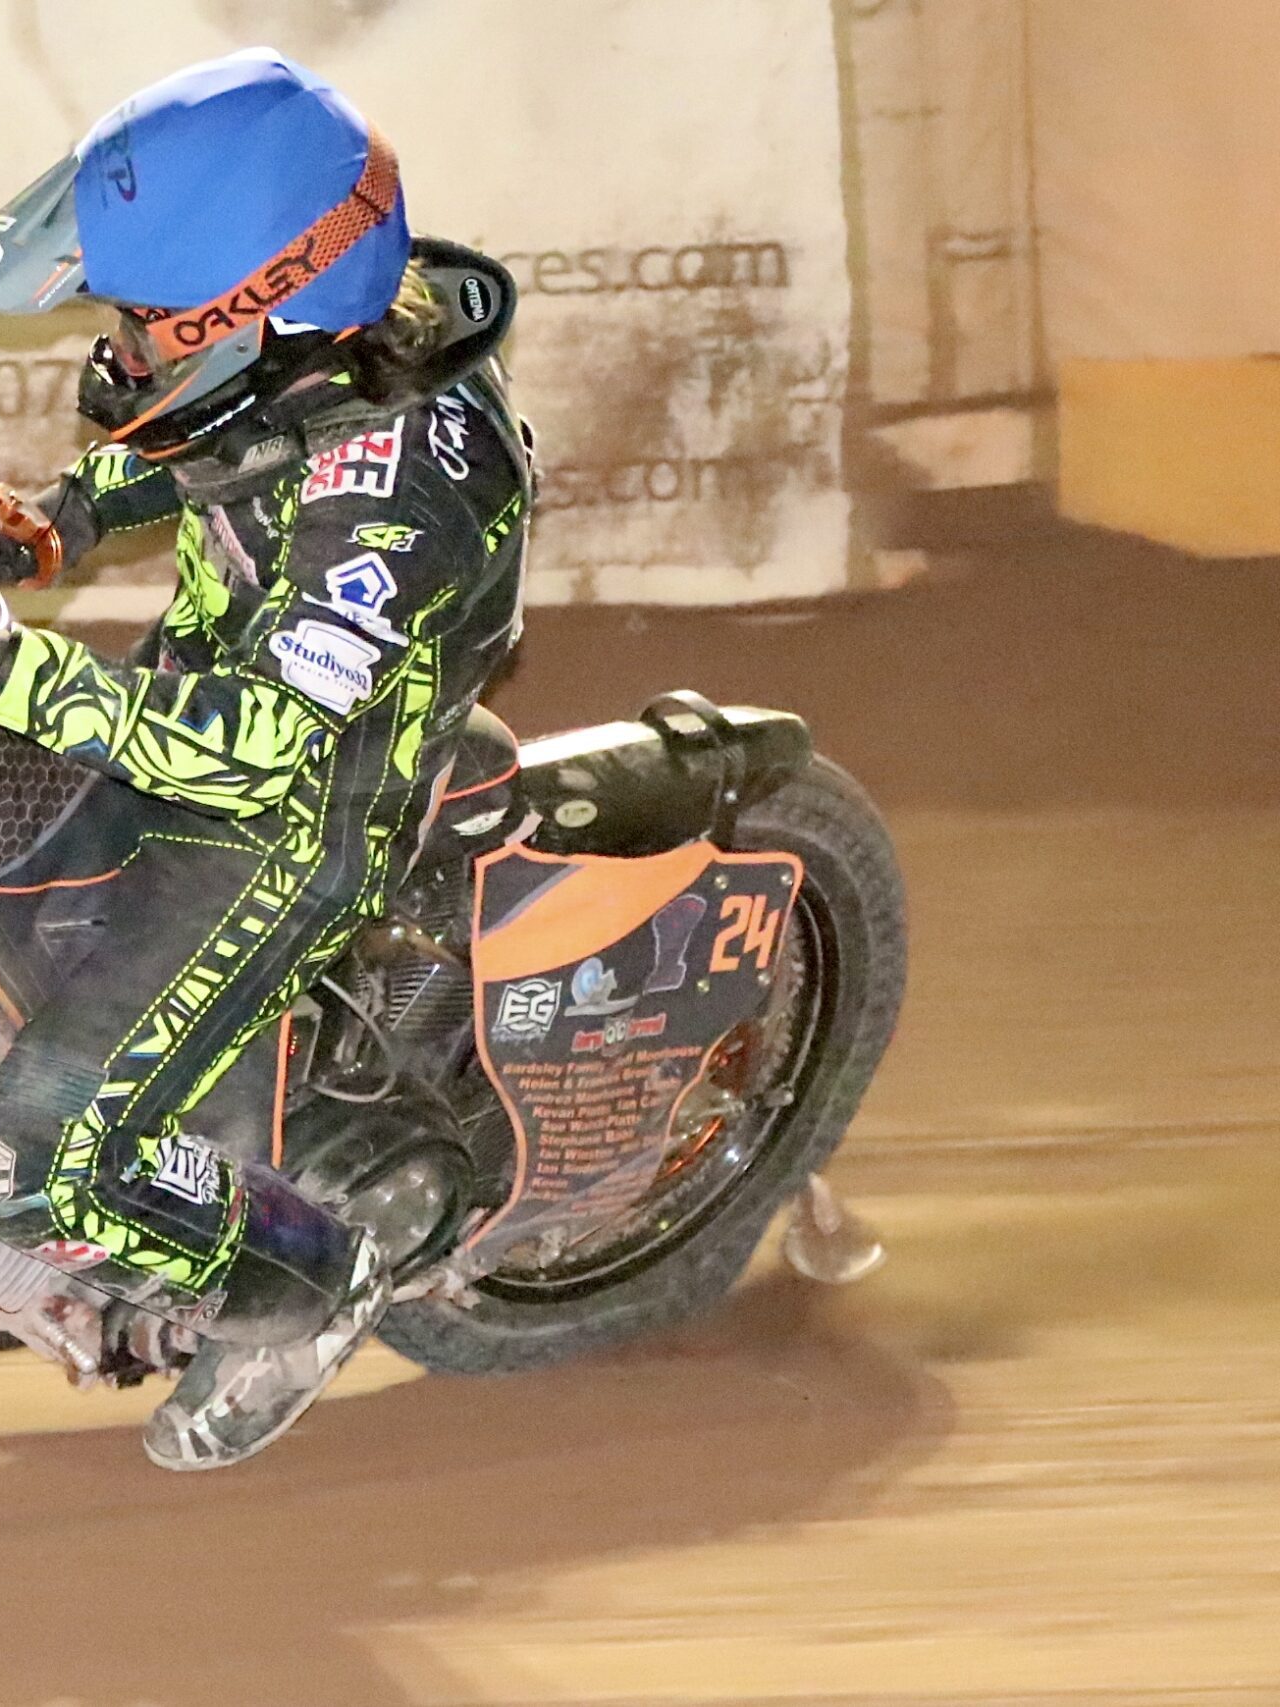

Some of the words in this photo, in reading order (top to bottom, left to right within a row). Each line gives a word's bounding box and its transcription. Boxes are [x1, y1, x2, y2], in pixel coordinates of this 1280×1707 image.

[173, 236, 320, 346] OAKLEY
[709, 894, 781, 973] 24
[500, 988, 559, 1027] EG
